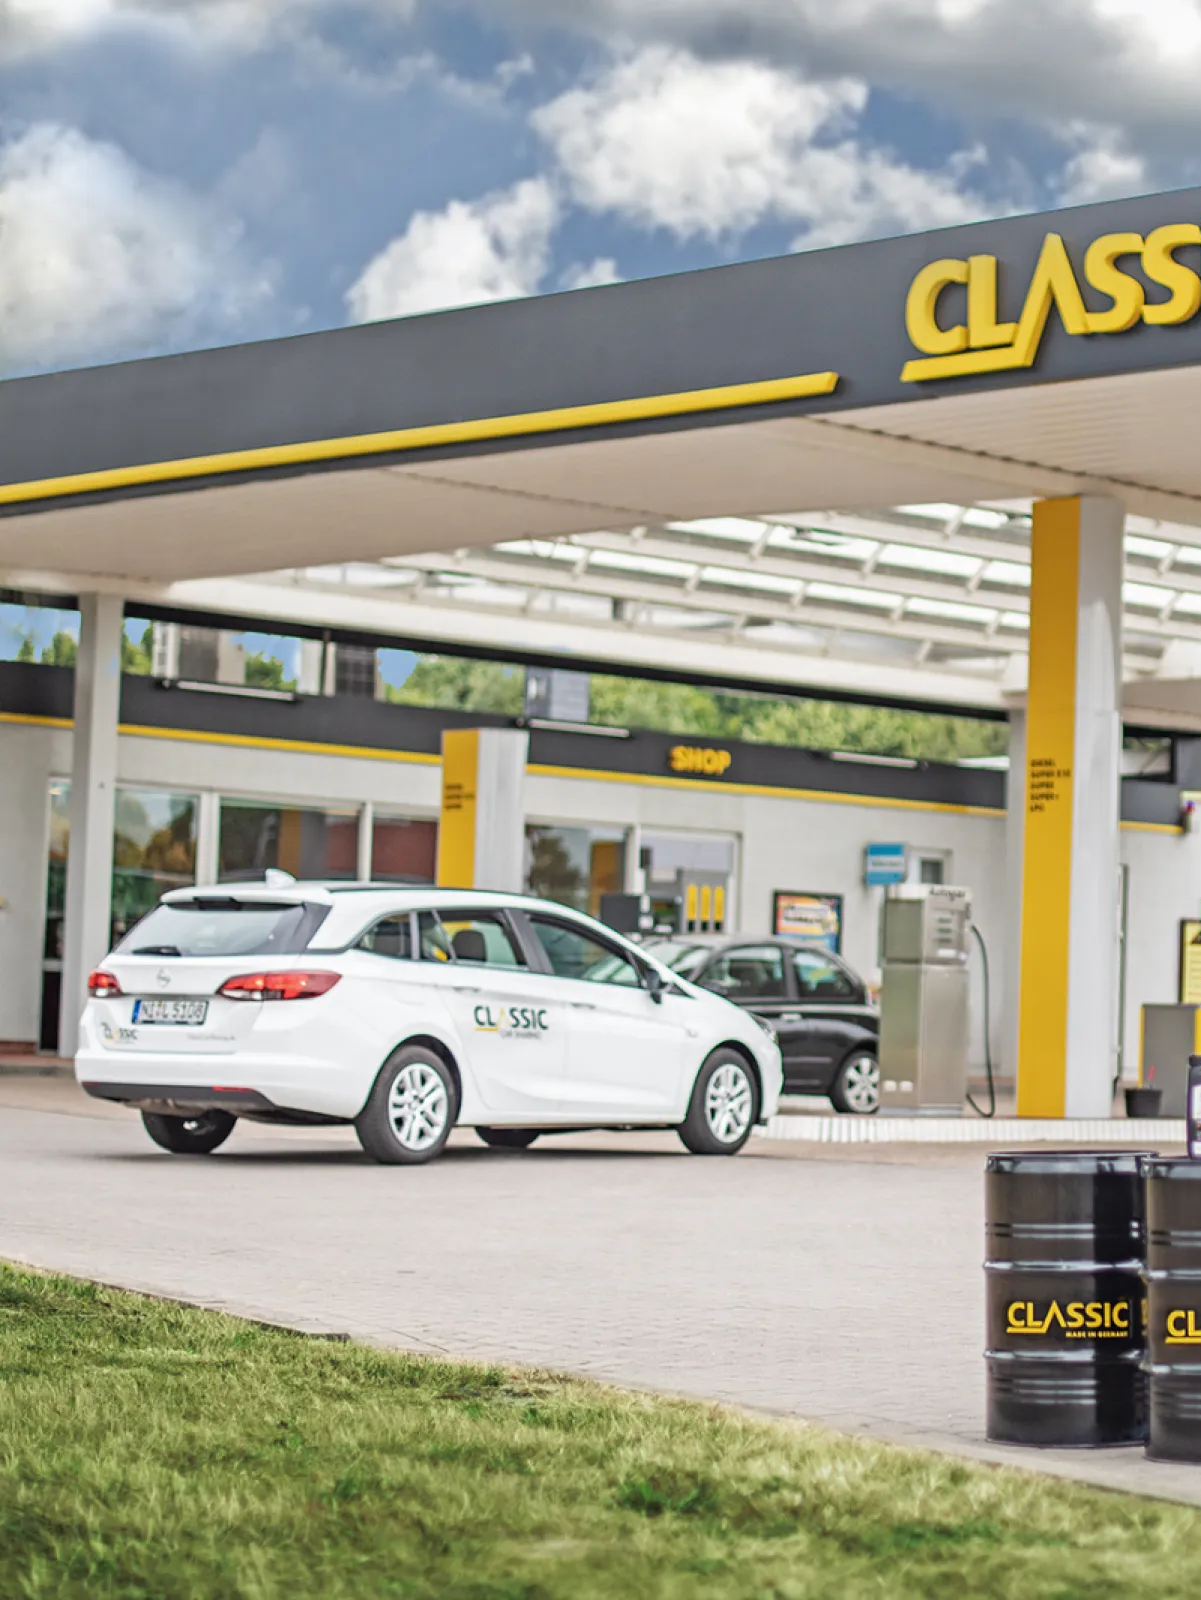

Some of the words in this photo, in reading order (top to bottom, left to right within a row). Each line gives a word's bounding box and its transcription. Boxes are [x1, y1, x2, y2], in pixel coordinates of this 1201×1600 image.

[670, 745, 732, 776] SHOP
[473, 1005, 549, 1033] CLASSIC
[1006, 1299, 1128, 1334] CLASSIC
